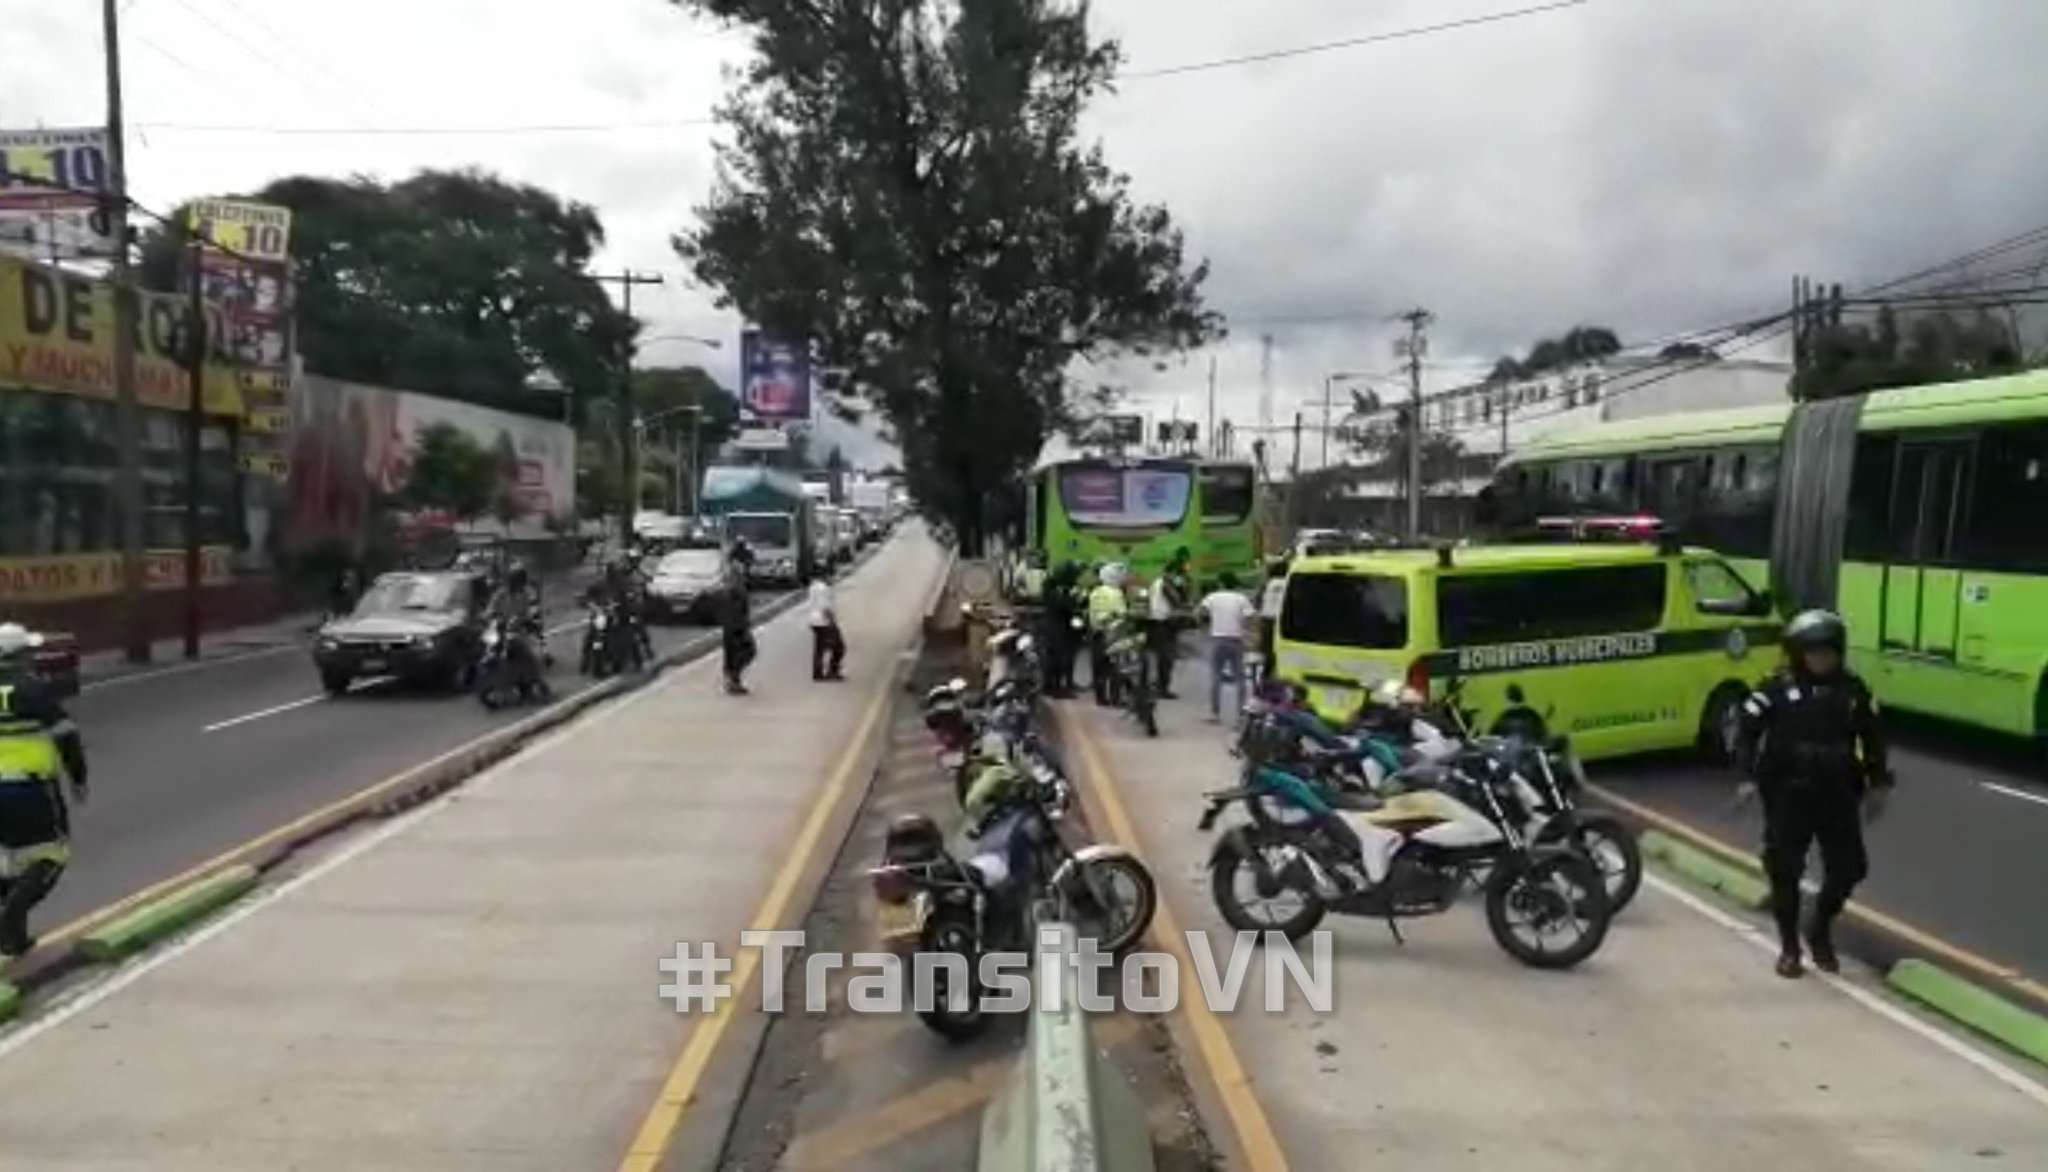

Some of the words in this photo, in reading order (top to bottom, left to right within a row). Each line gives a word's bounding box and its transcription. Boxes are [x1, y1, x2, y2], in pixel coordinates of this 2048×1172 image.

[244, 225, 282, 254] 10
[24, 268, 93, 342] DE
[1458, 641, 1550, 670] BOMBEROS
[1553, 632, 1656, 665] MUNICIPALES
